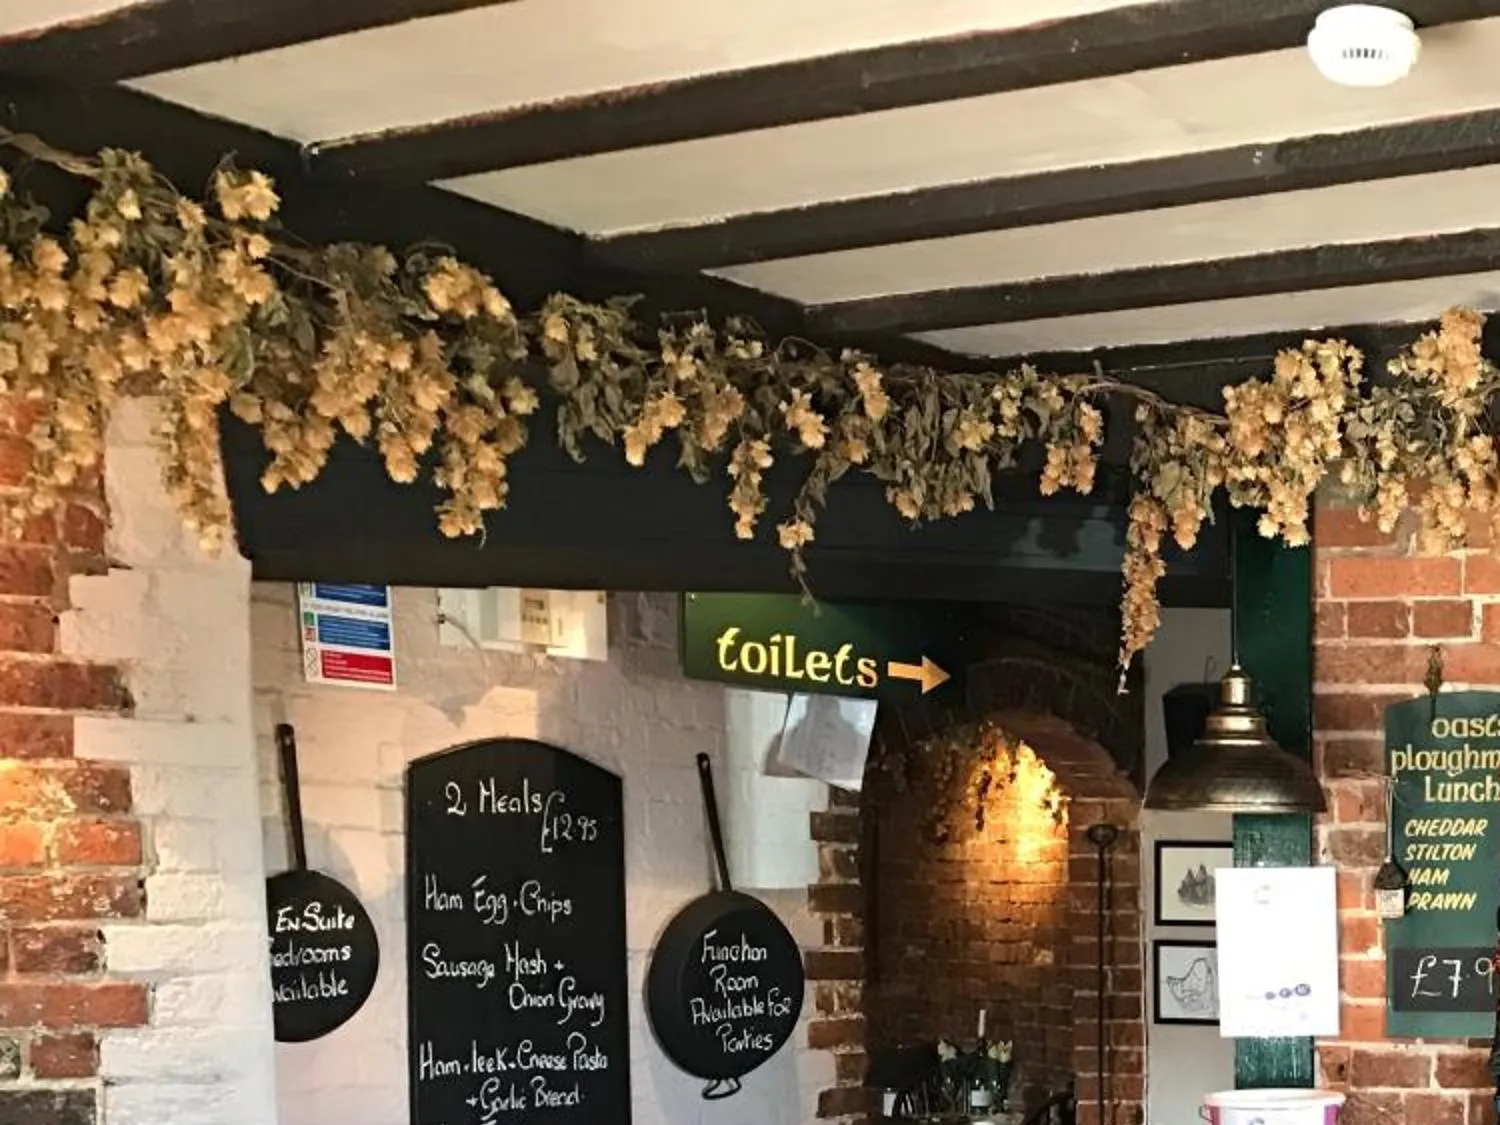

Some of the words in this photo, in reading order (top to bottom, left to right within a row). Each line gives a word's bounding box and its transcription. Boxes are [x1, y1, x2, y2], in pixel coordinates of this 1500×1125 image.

[445, 781, 467, 816] 2
[479, 777, 543, 814] Meals
[1404, 818, 1489, 838] CHEDDAR
[1404, 843, 1477, 861] STILTON
[1407, 867, 1450, 886] HAM
[425, 873, 463, 910] Ham
[472, 875, 508, 925] Egg
[1406, 891, 1478, 911] PRAWN
[268, 936, 352, 967] edrooms
[701, 929, 767, 963] Function
[422, 943, 495, 988] Sausage
[505, 940, 547, 981] Hash
[709, 963, 759, 998] Room
[272, 968, 348, 1002] vailable
[509, 982, 554, 1010] Onion
[558, 976, 604, 1027] Gravy
[690, 996, 764, 1025] Available
[567, 1032, 608, 1071] Pasta
[715, 1022, 773, 1053] Parties
[480, 1076, 526, 1121] Garlic
[530, 1075, 580, 1107] Bread
